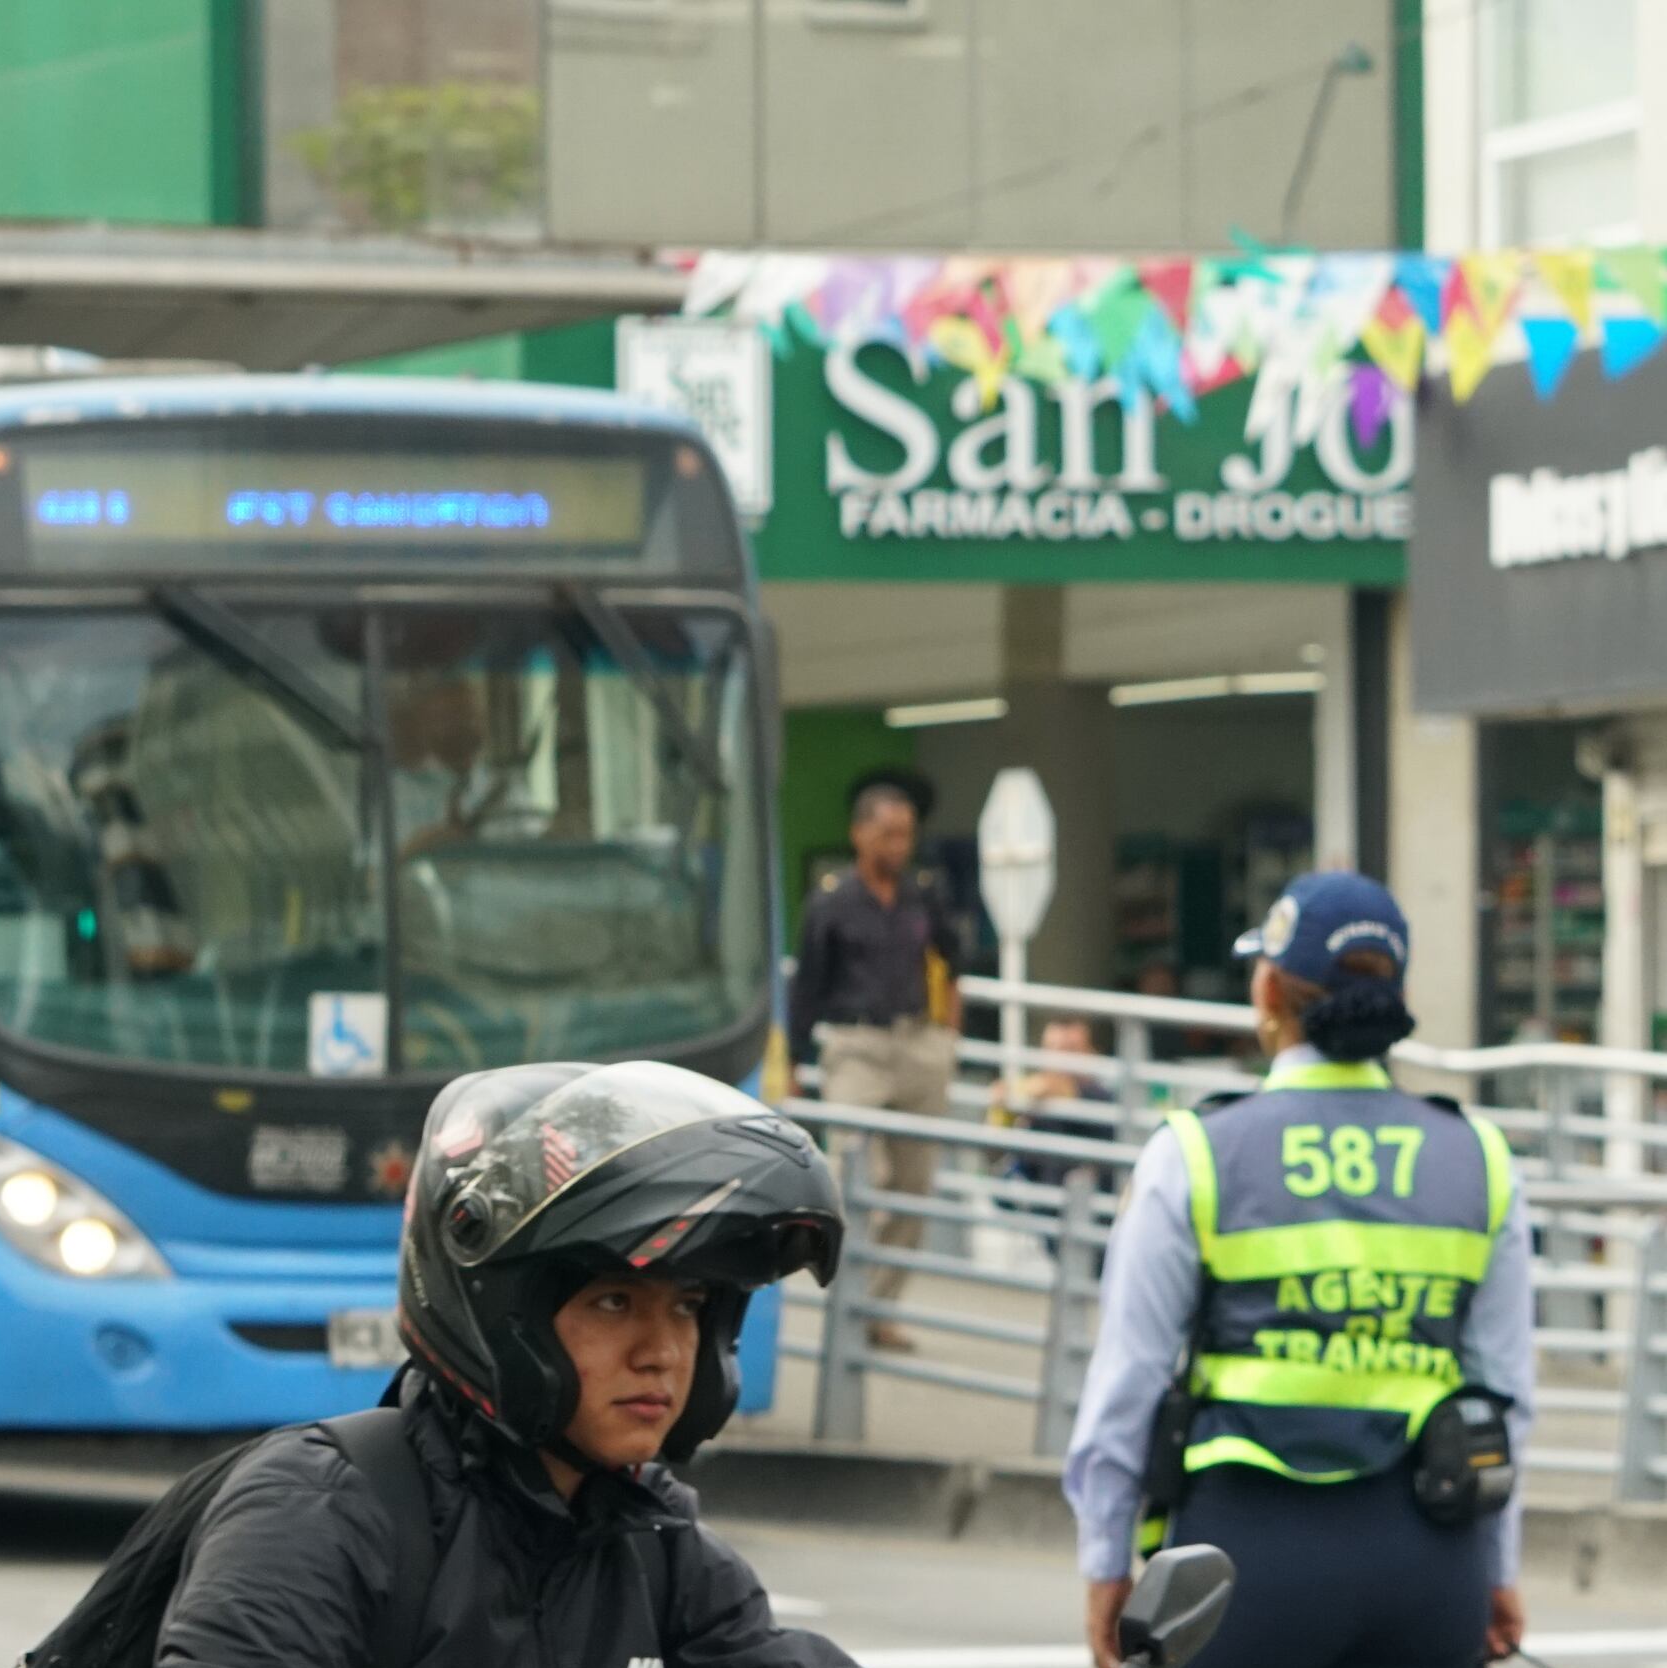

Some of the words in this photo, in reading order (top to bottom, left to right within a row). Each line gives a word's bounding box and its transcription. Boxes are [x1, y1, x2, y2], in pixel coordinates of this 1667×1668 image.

[825, 335, 1167, 494] San
[839, 493, 1134, 539] FARMACIA
[1281, 1123, 1425, 1197] 587
[1275, 1268, 1462, 1319] AGENTE
